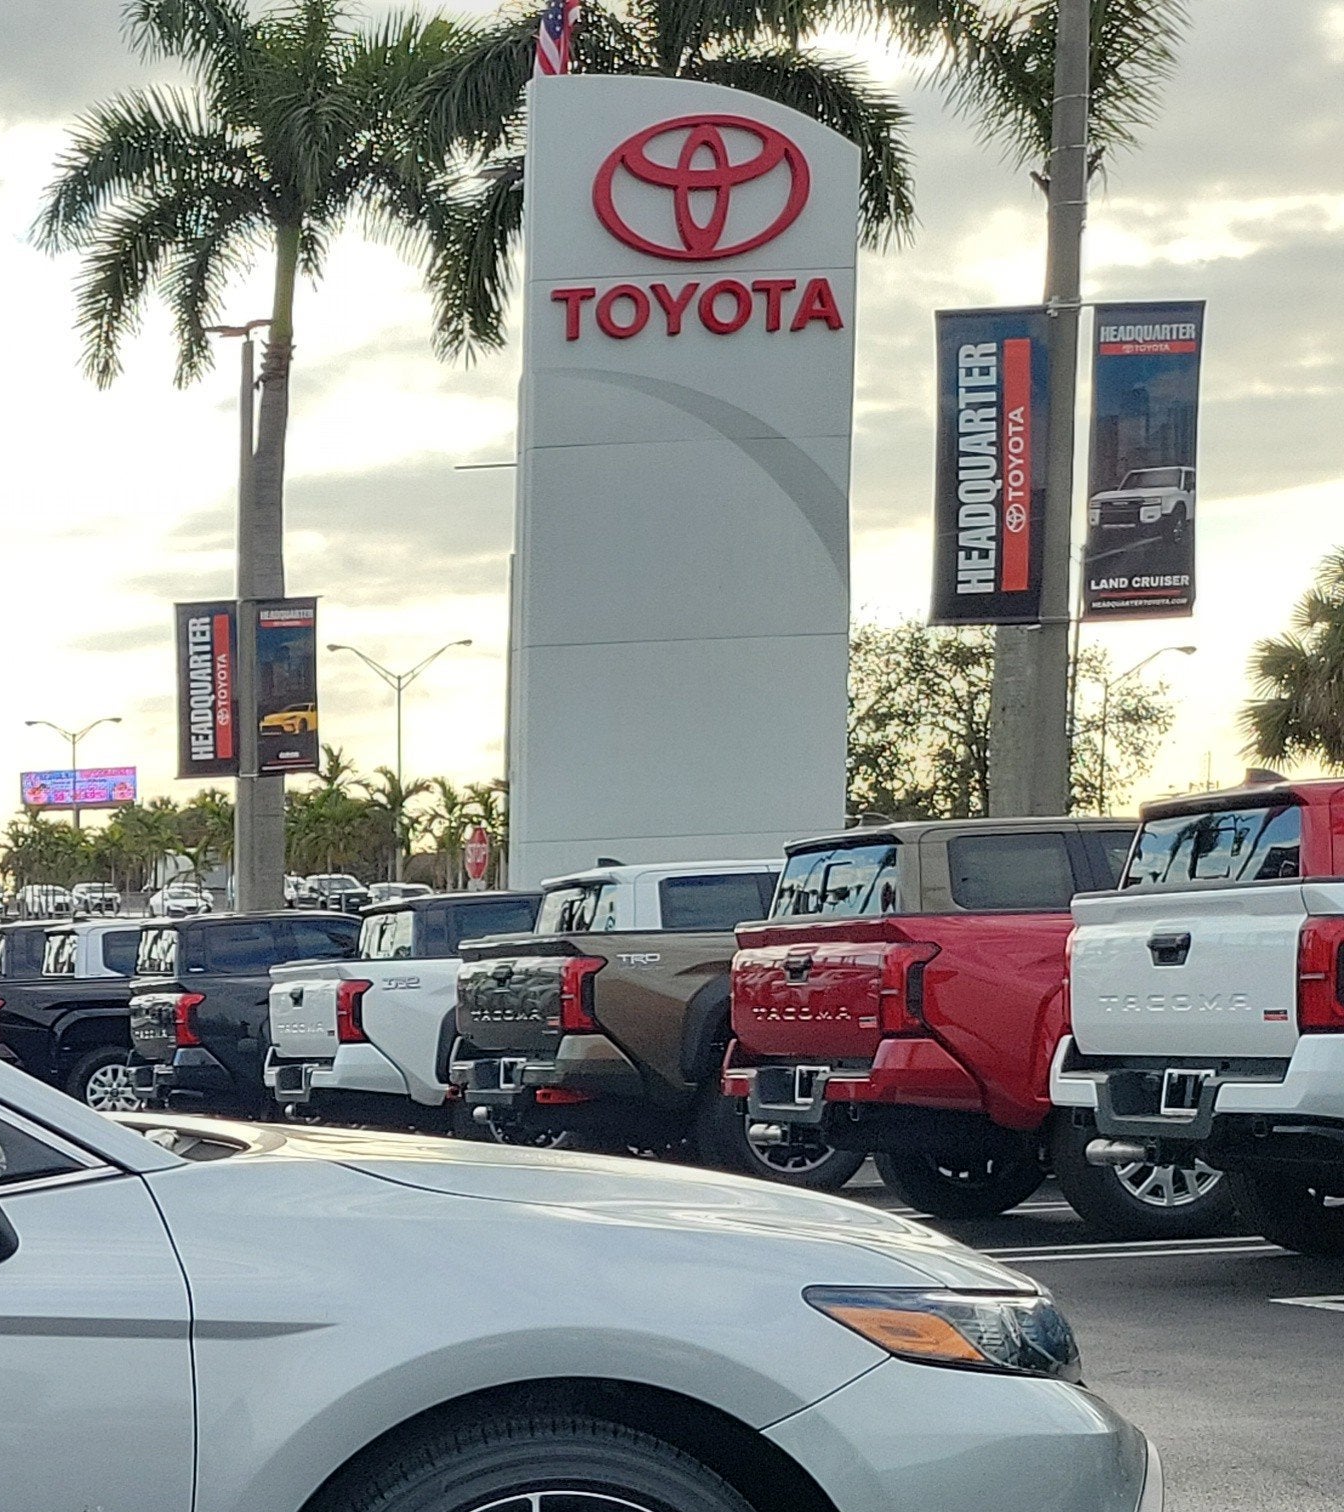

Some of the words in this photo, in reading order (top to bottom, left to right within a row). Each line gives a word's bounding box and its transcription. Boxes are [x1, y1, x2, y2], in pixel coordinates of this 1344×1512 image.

[550, 278, 844, 341] TOYOTA
[1100, 324, 1196, 343] HEADQUARTER
[1008, 406, 1024, 501] TOYOTA
[957, 342, 1002, 594] HEADQUARTER
[1090, 578, 1128, 590] LAND
[1132, 575, 1190, 588] CRUISER
[189, 616, 216, 761] HEADQUARTER
[217, 654, 229, 708] TOYOTA
[466, 843, 488, 864] STOP
[617, 954, 661, 964] TRD
[752, 1006, 852, 1020] TACOMA
[1099, 994, 1252, 1012] TACOMA
[470, 1009, 542, 1021] TACOMA
